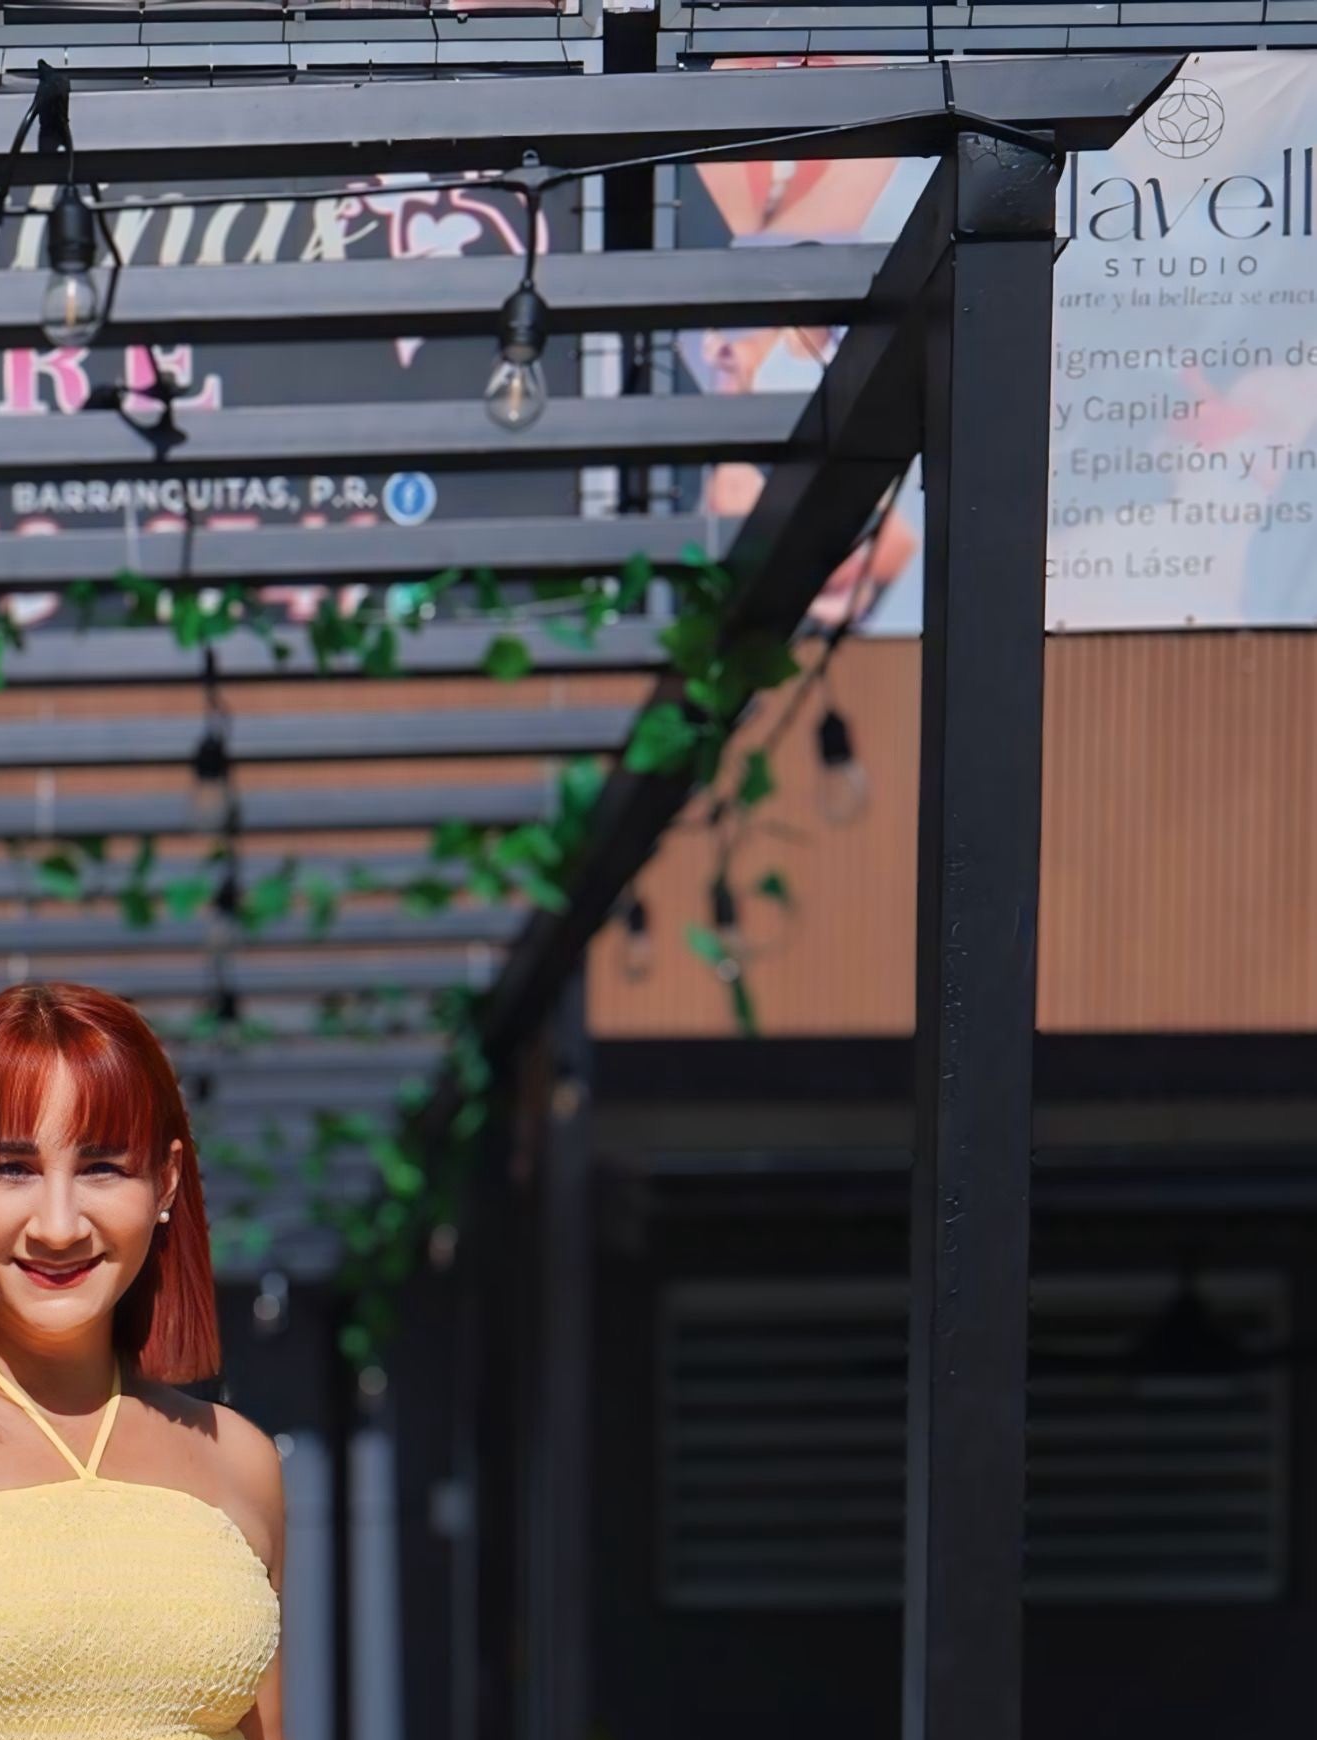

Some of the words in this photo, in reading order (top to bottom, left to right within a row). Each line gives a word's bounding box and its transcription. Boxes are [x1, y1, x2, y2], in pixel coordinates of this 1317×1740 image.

[1104, 255, 1258, 278] STUDIO
[1059, 289, 1106, 309] arte
[1111, 290, 1126, 315] y
[1131, 287, 1151, 308] la
[1157, 286, 1233, 308] belleza
[1239, 289, 1263, 306] se
[1053, 402, 1073, 431] y
[1083, 393, 1206, 429] Capilar
[1070, 441, 1228, 483] Epilación
[1238, 451, 1257, 480] y
[11, 475, 301, 514] BARRANQUITAS,
[309, 474, 378, 508] P.R.
[1115, 498, 1156, 527] de
[1164, 497, 1314, 533] Tatuajes
[1124, 547, 1216, 579] Láser
